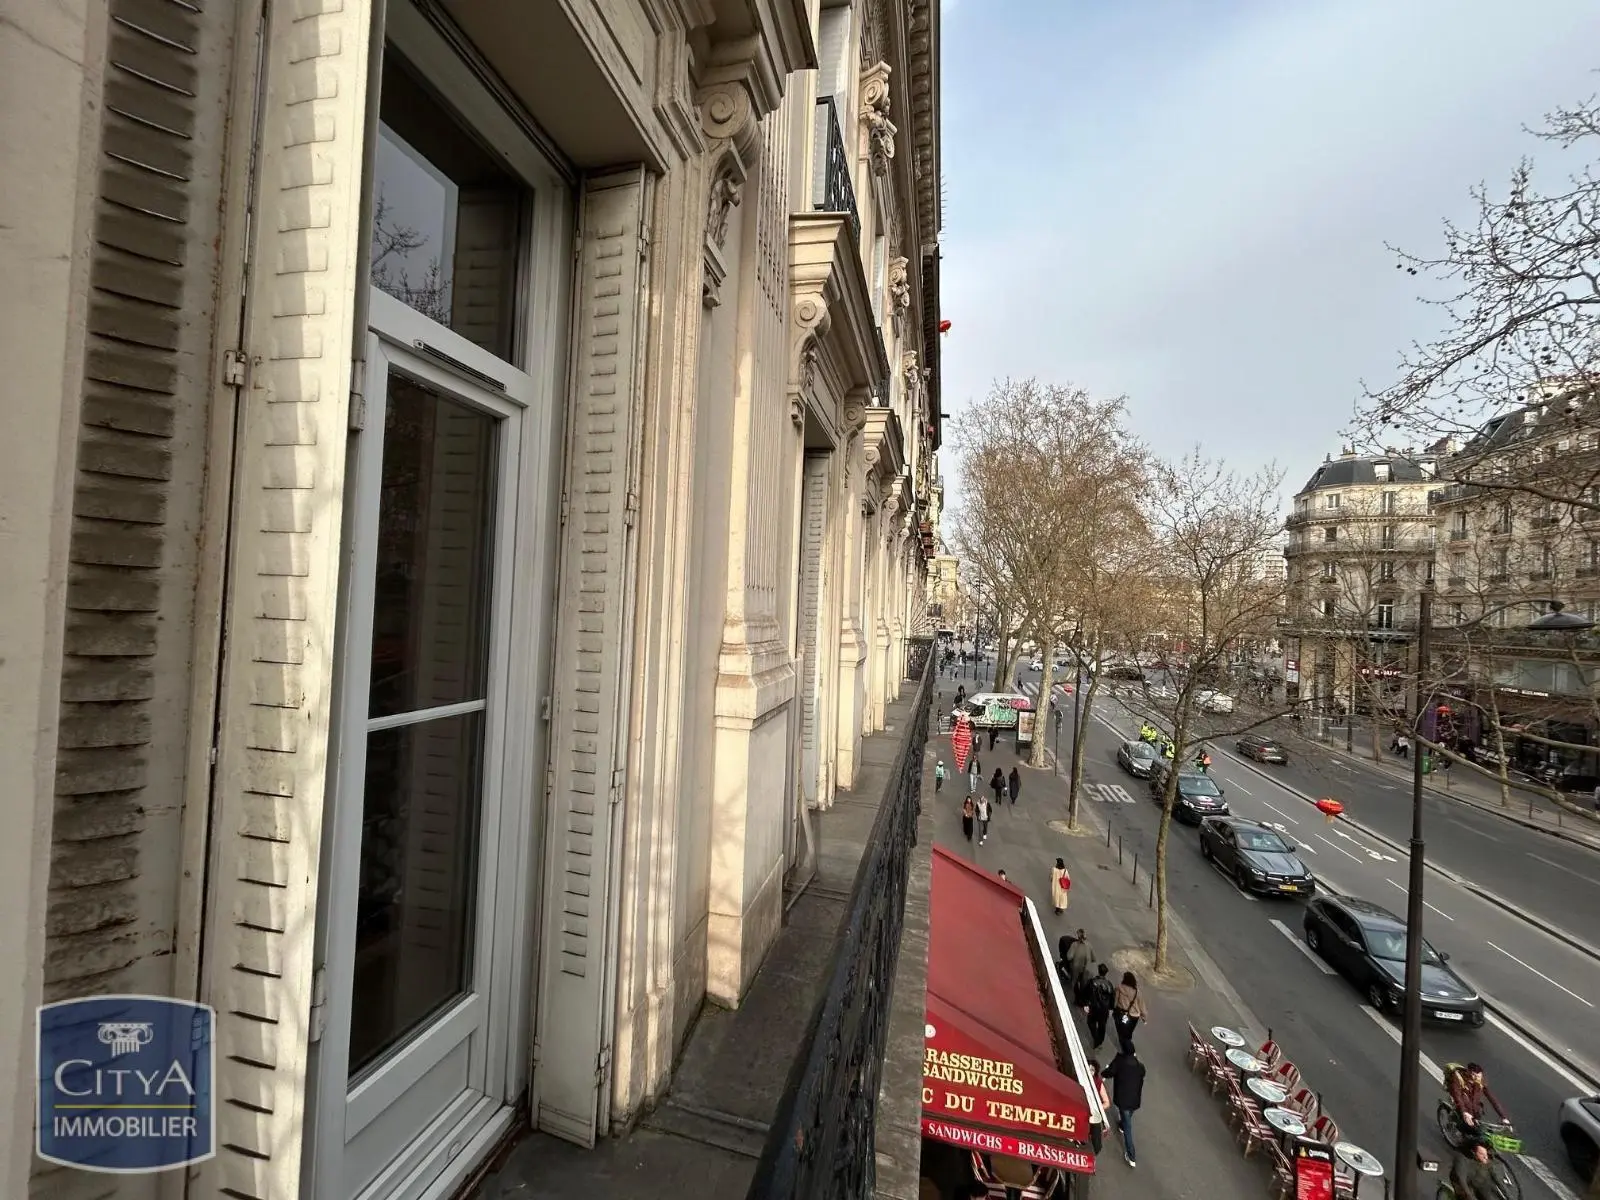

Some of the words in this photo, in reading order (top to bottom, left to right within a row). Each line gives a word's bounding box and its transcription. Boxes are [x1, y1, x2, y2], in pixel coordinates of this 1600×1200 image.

[1082, 784, 1136, 803] BUS
[923, 1047, 1014, 1077] RASSERIE
[944, 1092, 975, 1113] DU
[986, 1100, 1076, 1133] TEMPLE
[928, 1123, 1003, 1150] SANDWICHS
[1018, 1141, 1090, 1168] BRASSERIE
